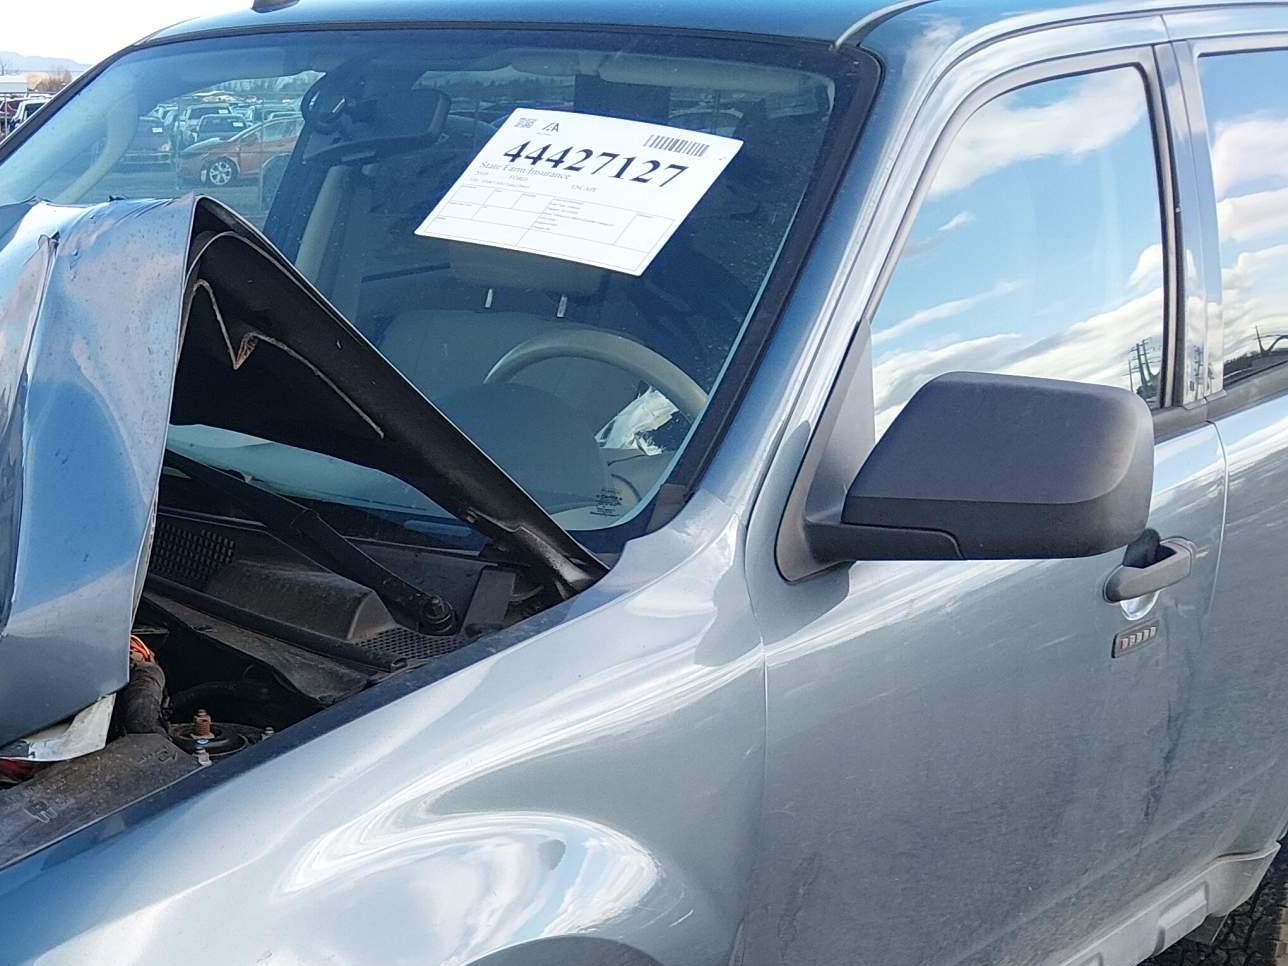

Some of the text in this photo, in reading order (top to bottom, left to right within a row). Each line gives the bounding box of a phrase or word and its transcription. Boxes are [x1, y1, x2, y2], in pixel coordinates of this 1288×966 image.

[479, 160, 572, 181] State Farm Insurance
[503, 140, 689, 188] 44427127
